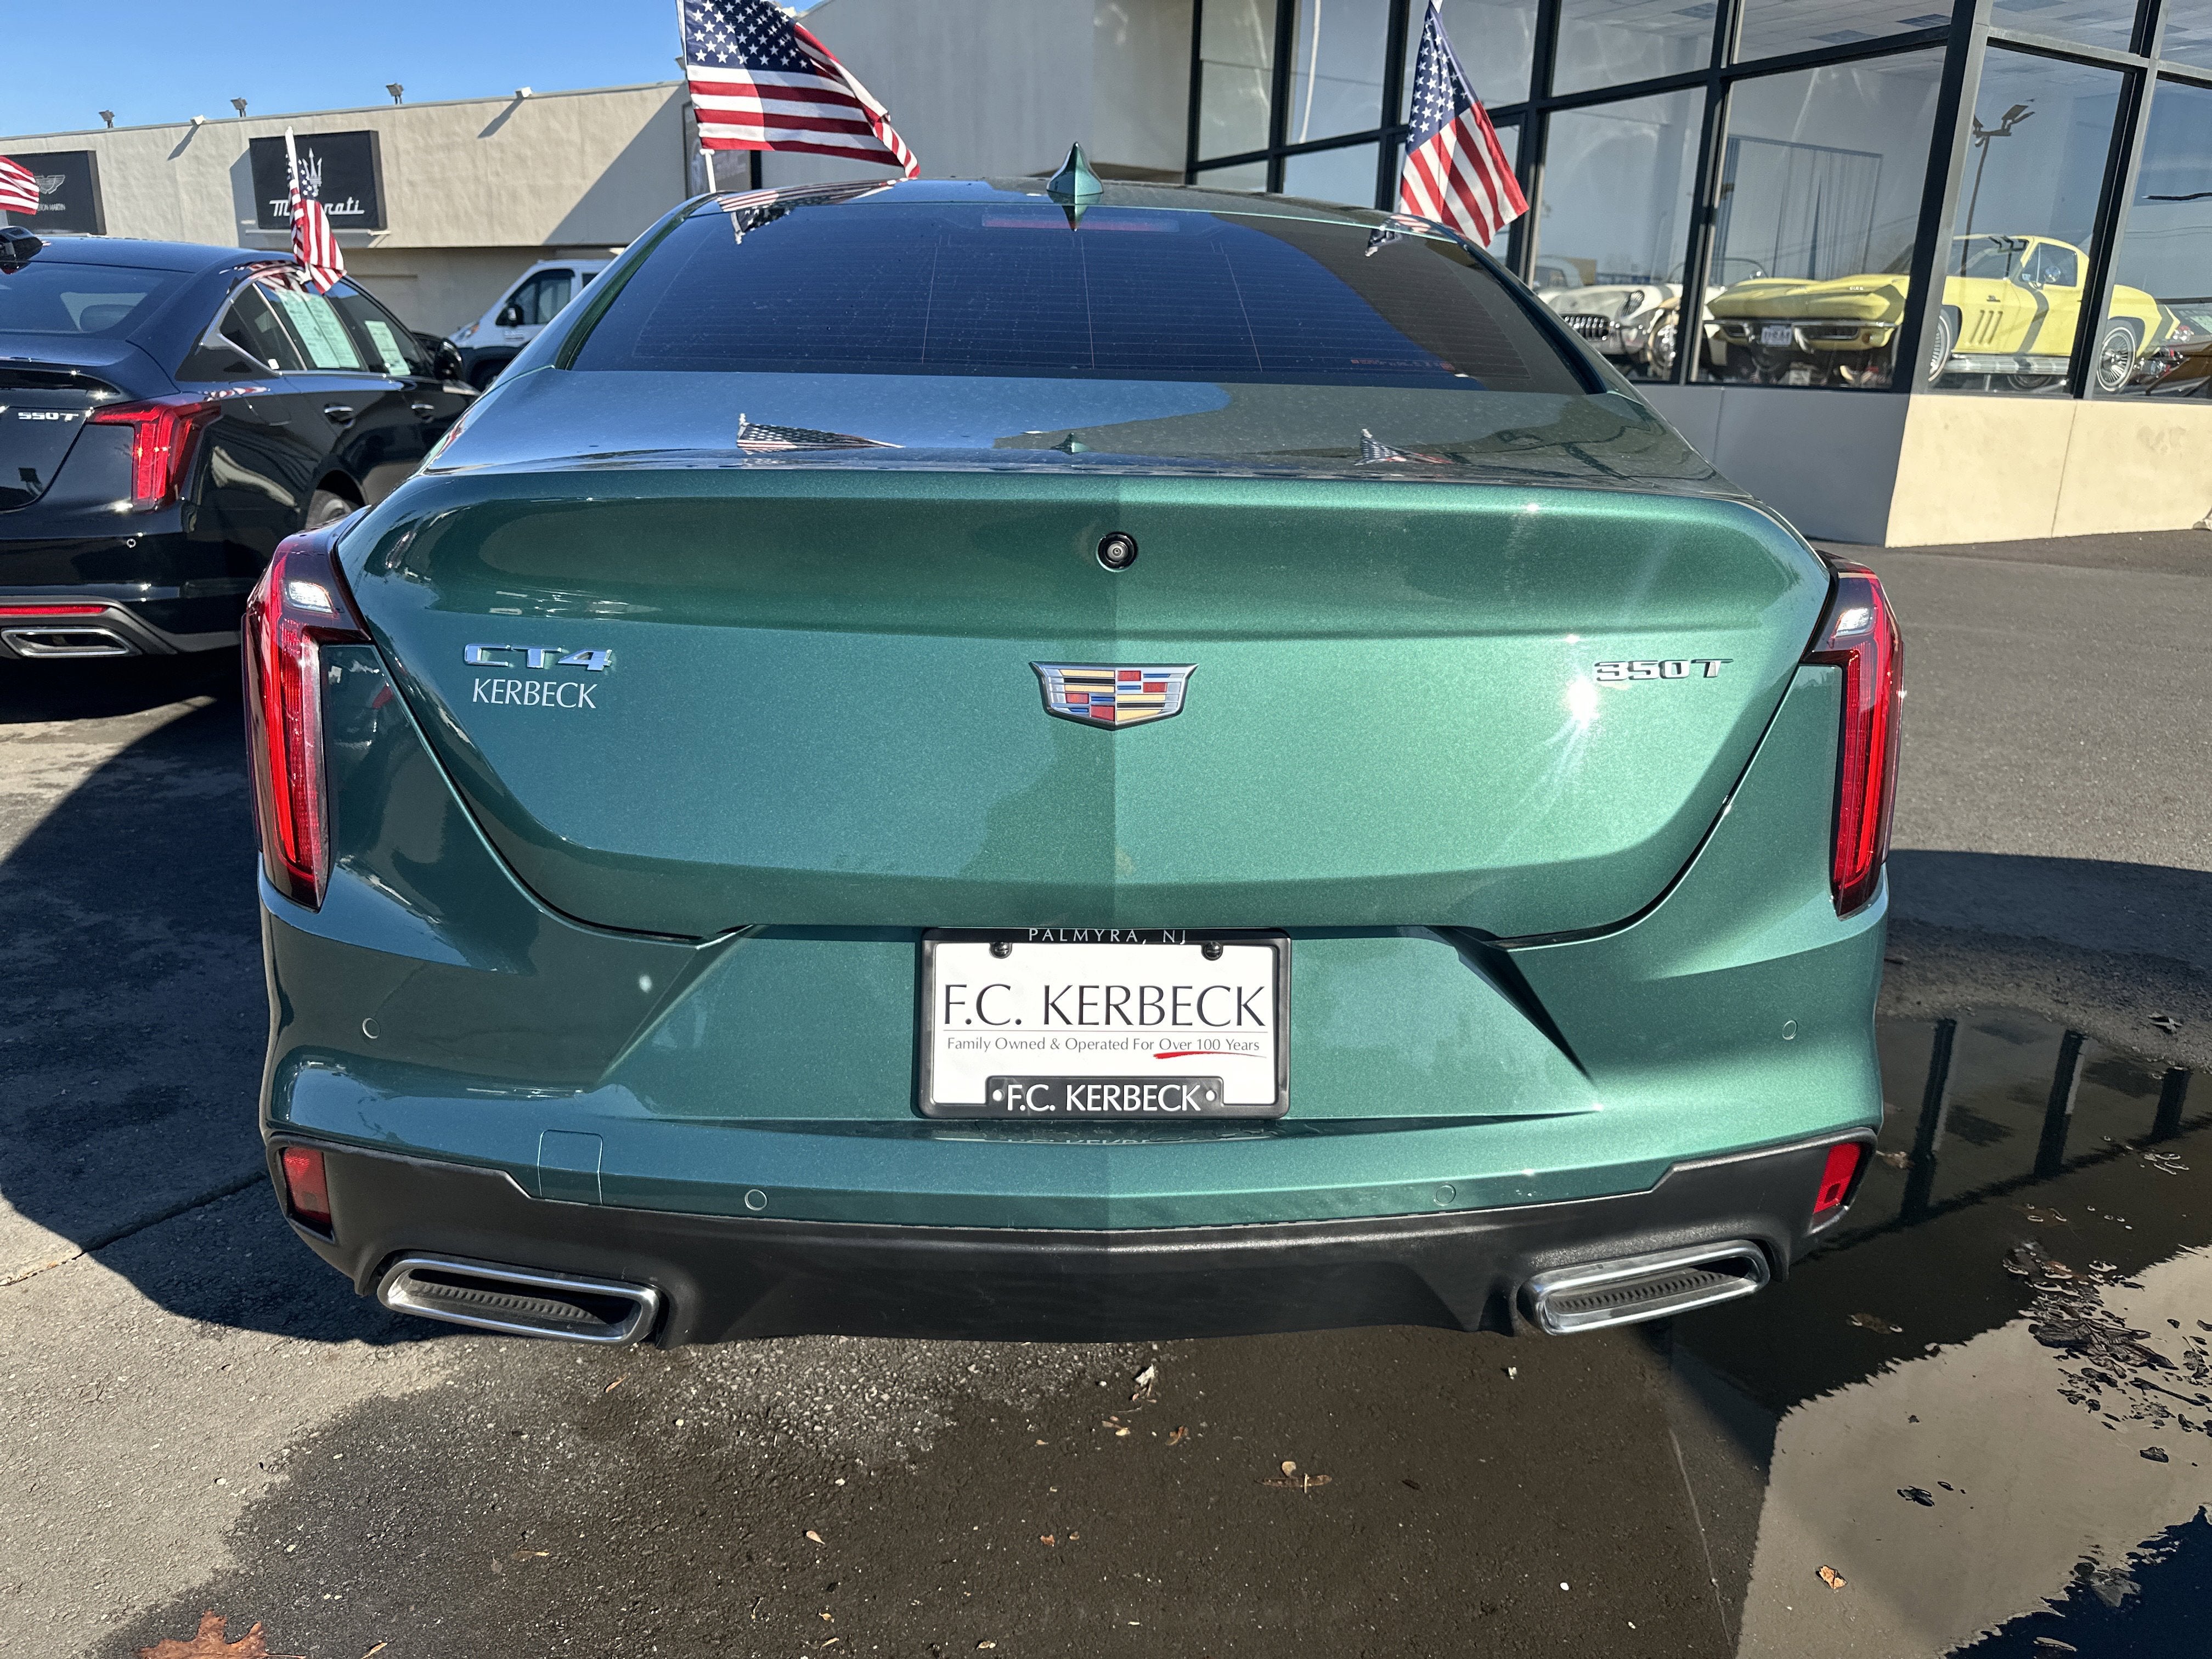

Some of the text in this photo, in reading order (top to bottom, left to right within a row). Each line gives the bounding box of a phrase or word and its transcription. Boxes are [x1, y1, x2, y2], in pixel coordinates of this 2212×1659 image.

[269, 196, 365, 217] Mrati
[464, 643, 613, 672] CT4
[472, 678, 598, 709] KERBECK
[1029, 928, 1186, 945] PALMYRA, NJ
[945, 984, 1266, 1027] F.C. KERBECK
[948, 1036, 1260, 1053] Family Owned & Operated For Over 100 Years
[1007, 1084, 1201, 1111] F.C. KERBECK
